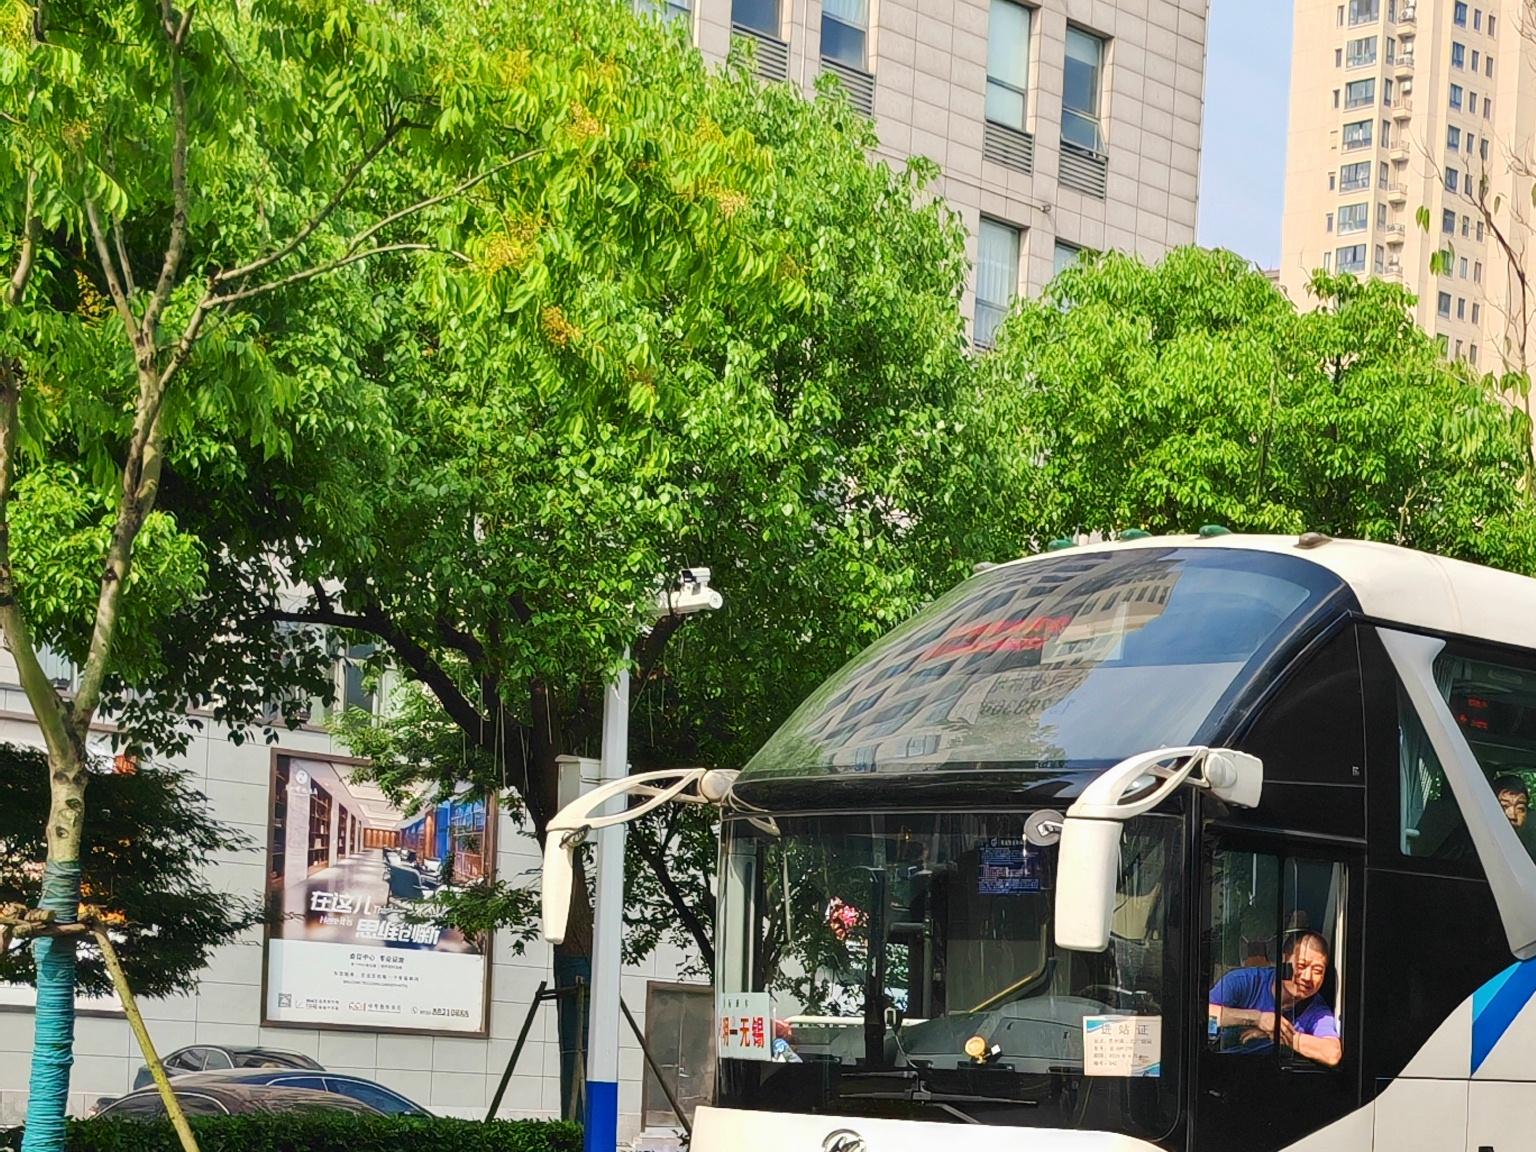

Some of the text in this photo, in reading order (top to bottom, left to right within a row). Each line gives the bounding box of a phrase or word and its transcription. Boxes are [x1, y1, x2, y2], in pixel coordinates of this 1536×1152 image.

[310, 890, 372, 916] 在这儿
[1101, 1023, 1150, 1036] 进站证
